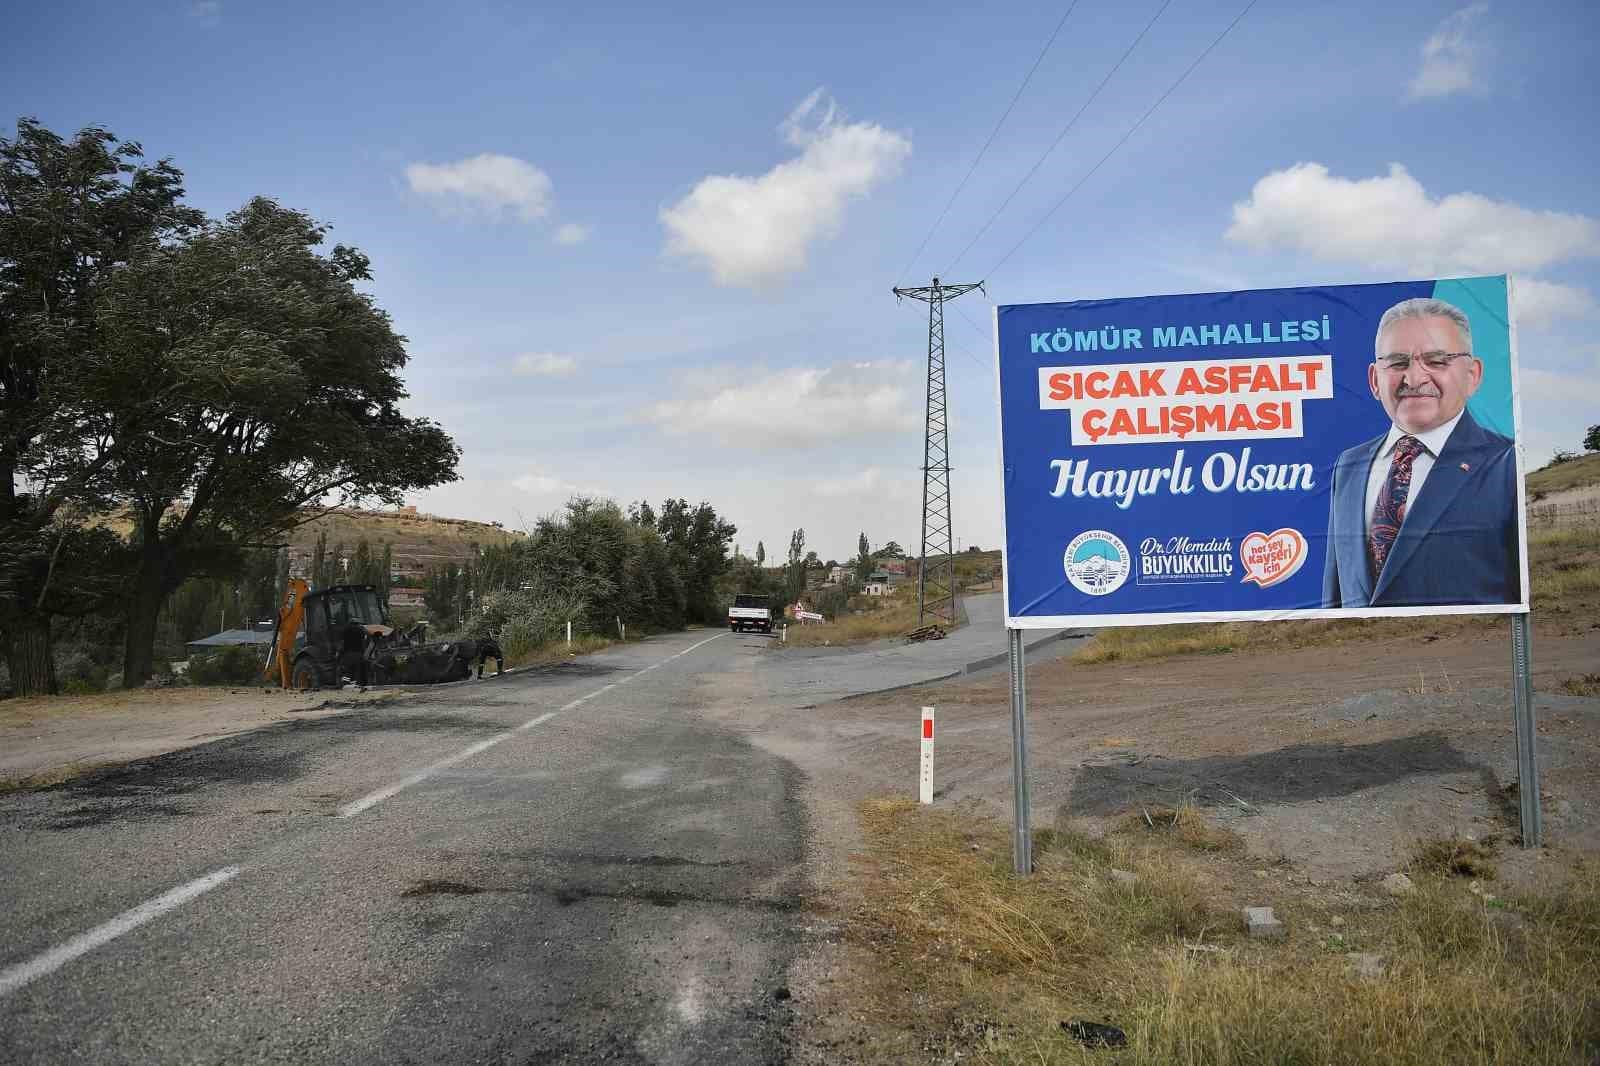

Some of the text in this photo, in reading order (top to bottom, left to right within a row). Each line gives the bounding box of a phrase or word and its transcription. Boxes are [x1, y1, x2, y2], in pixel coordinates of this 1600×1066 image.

[1030, 314, 1330, 353] KÖMÜR MAHALLESİ
[1048, 362, 1323, 401] SICAK ASFALT
[1081, 402, 1293, 443] ÇALIŞMASI
[1049, 447, 1316, 510] Hayırlı Olsun
[1165, 536, 1233, 555] Memduh
